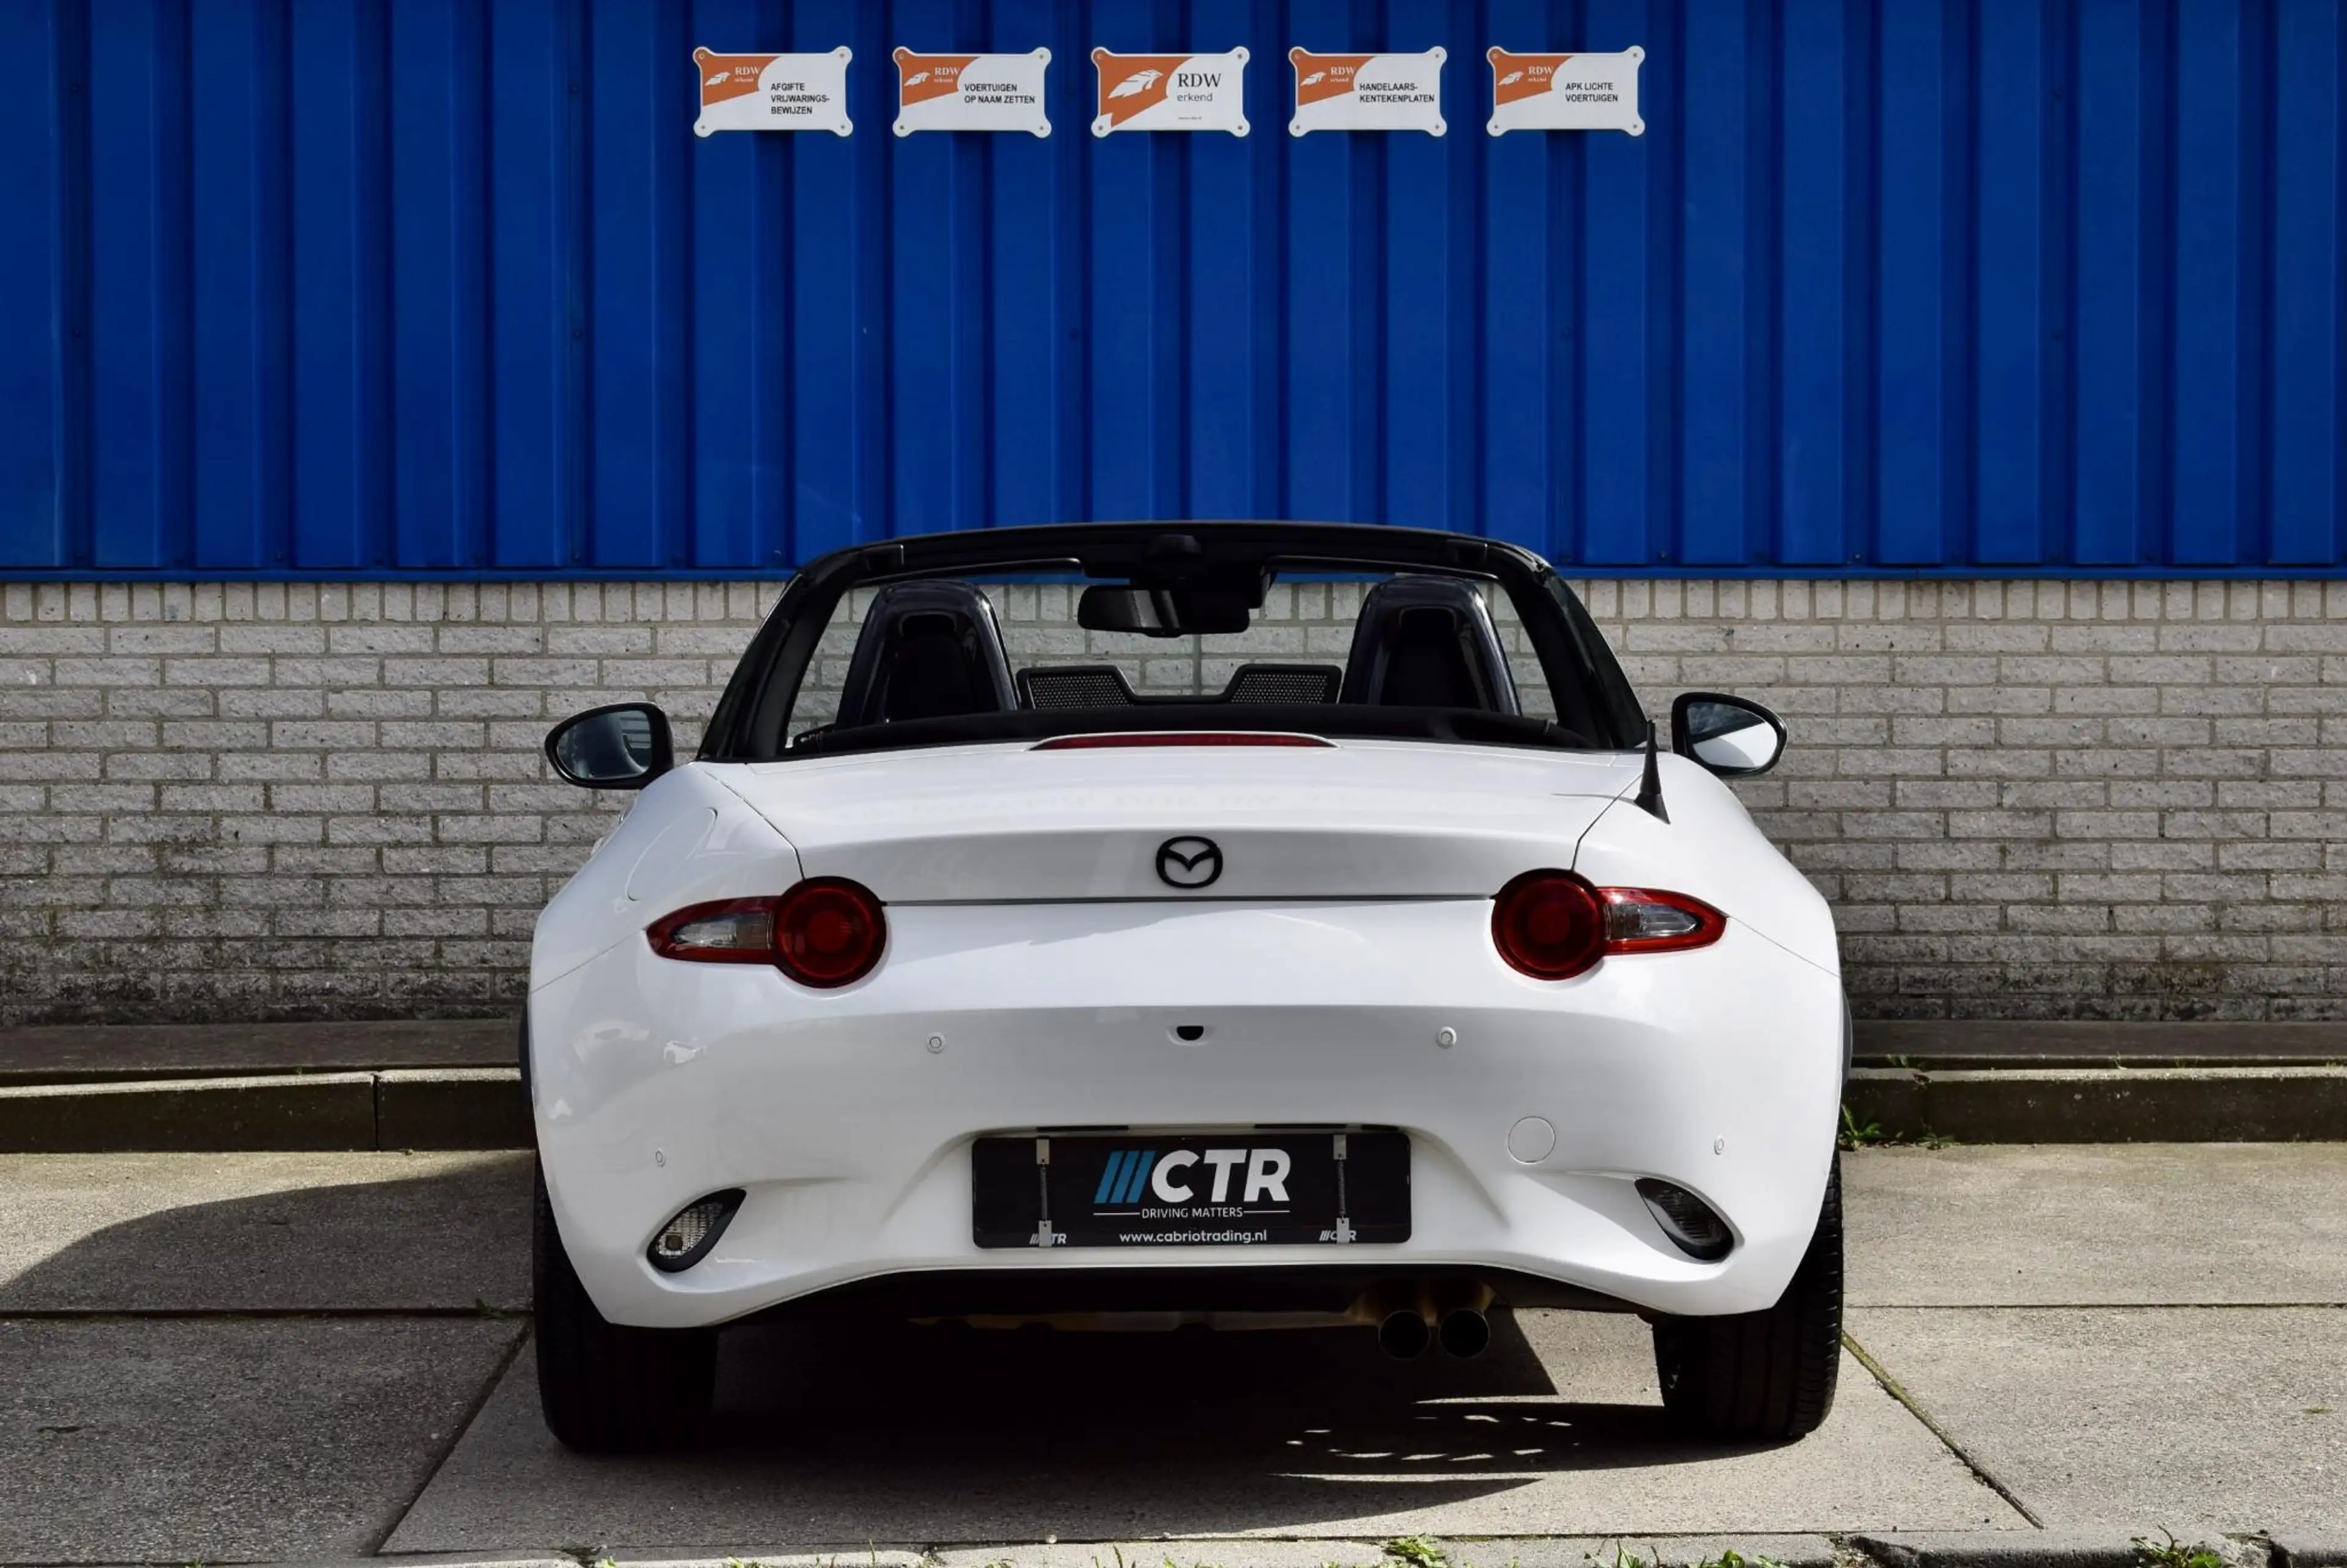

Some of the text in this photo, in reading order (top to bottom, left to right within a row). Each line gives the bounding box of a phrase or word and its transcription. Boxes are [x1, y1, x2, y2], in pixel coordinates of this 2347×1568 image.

[735, 67, 760, 75] RDW
[1330, 67, 1356, 75] RDW
[1528, 66, 1554, 75] RDW
[1177, 73, 1221, 87] RDW
[964, 83, 1017, 92] VOERTUIGEN
[1004, 95, 1035, 104] ZETTEN
[1177, 93, 1213, 102] erkend
[1151, 1149, 1291, 1203] CTR
[1142, 1207, 1243, 1218] DRIVING MATTERS
[1119, 1229, 1267, 1244] www.cabriotrading.nl
[1330, 1229, 1356, 1241] CR
